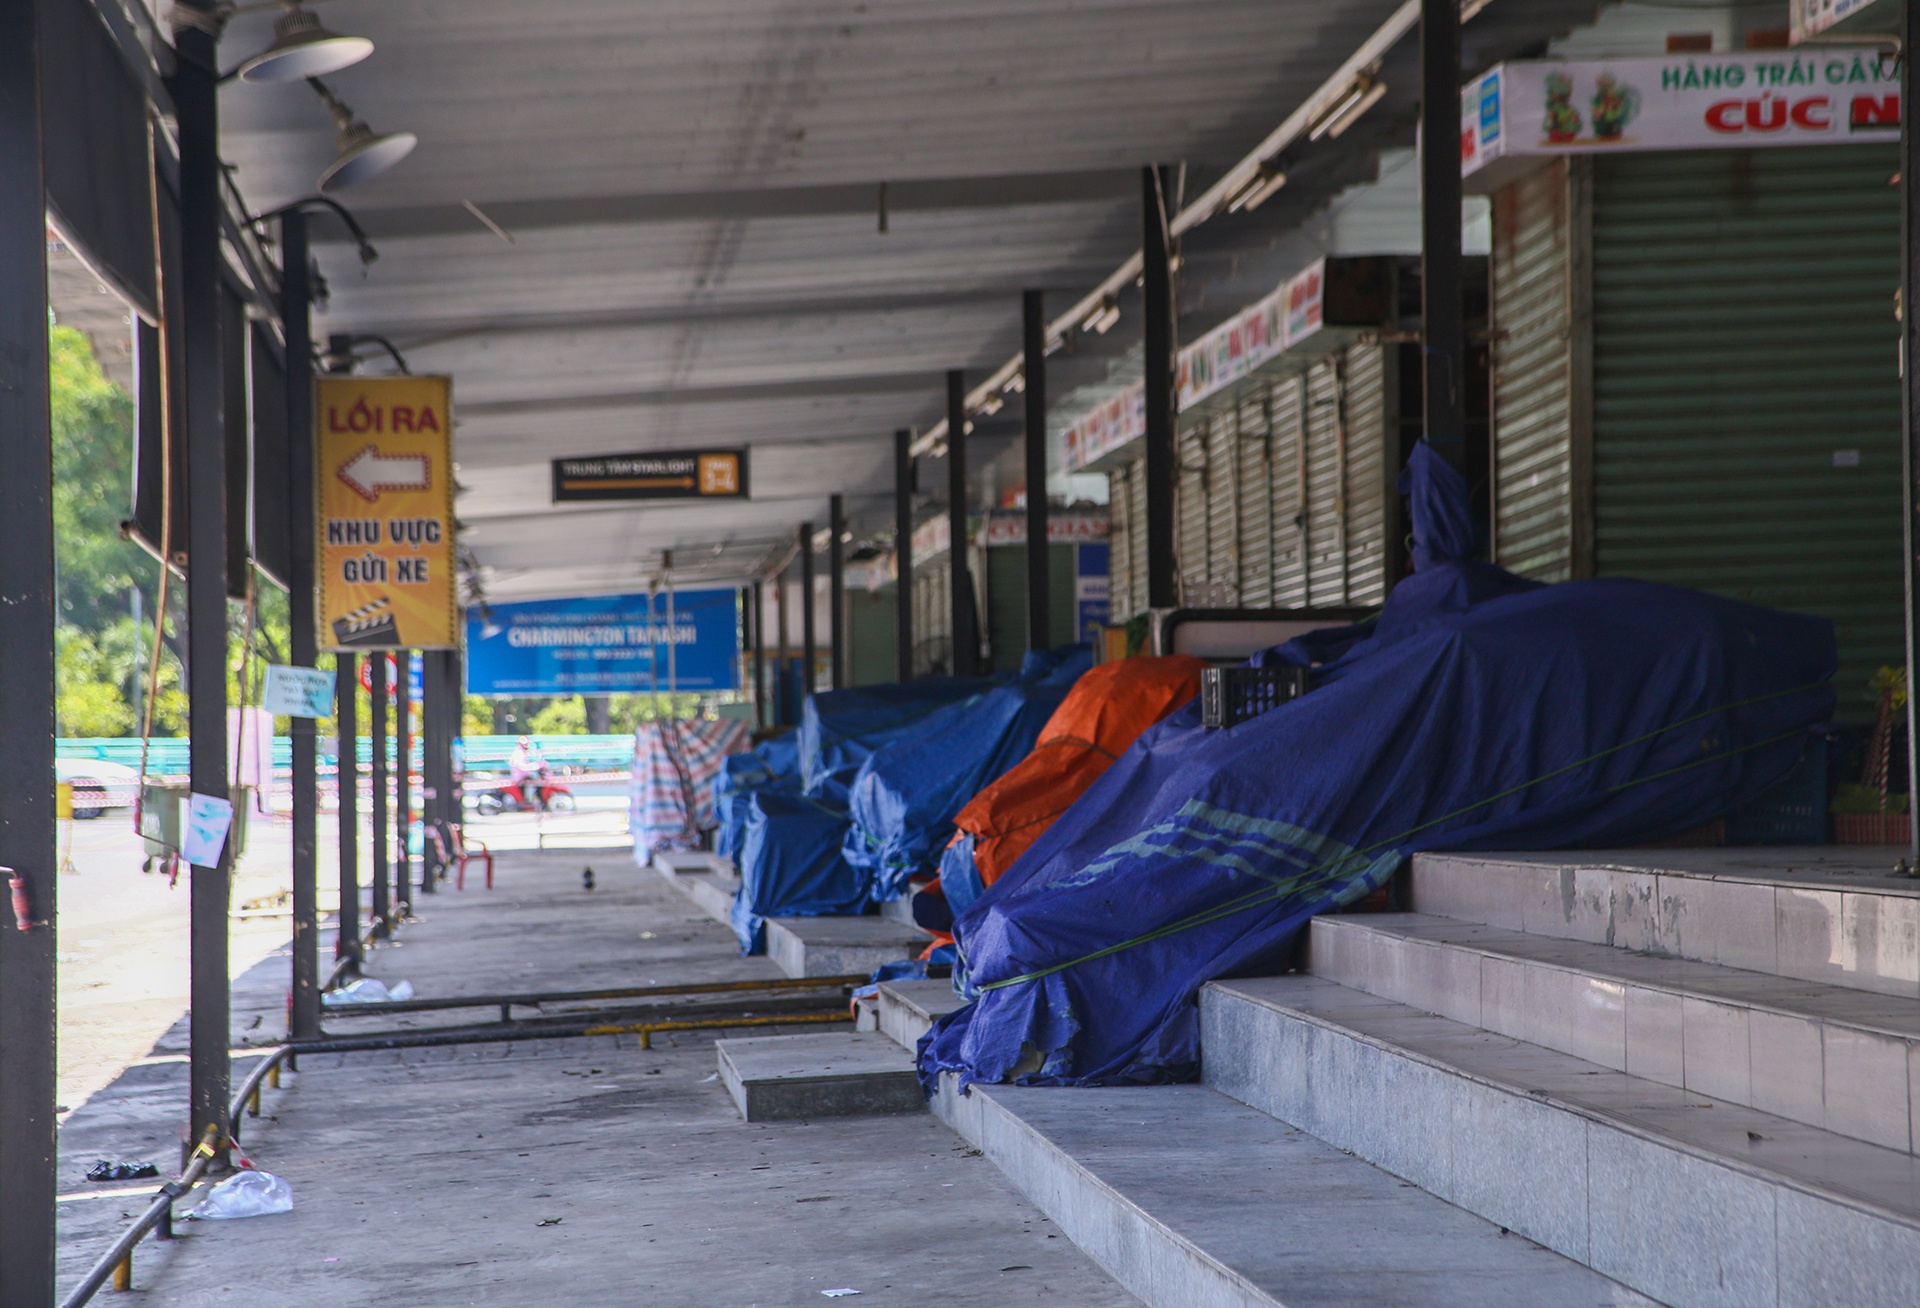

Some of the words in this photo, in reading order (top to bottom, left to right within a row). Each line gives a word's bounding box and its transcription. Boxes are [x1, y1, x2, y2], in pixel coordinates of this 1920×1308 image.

[1660, 58, 1746, 91] HÀNG
[1754, 54, 1816, 88] TRÁI
[1704, 90, 1831, 134] CÚC
[328, 394, 384, 433] LỐI
[391, 405, 440, 433] RA
[327, 519, 381, 545] KHU
[390, 517, 442, 550] VỰC
[343, 553, 388, 583] GỬI
[397, 557, 429, 582] XE
[507, 625, 625, 648] CHARMINGTON
